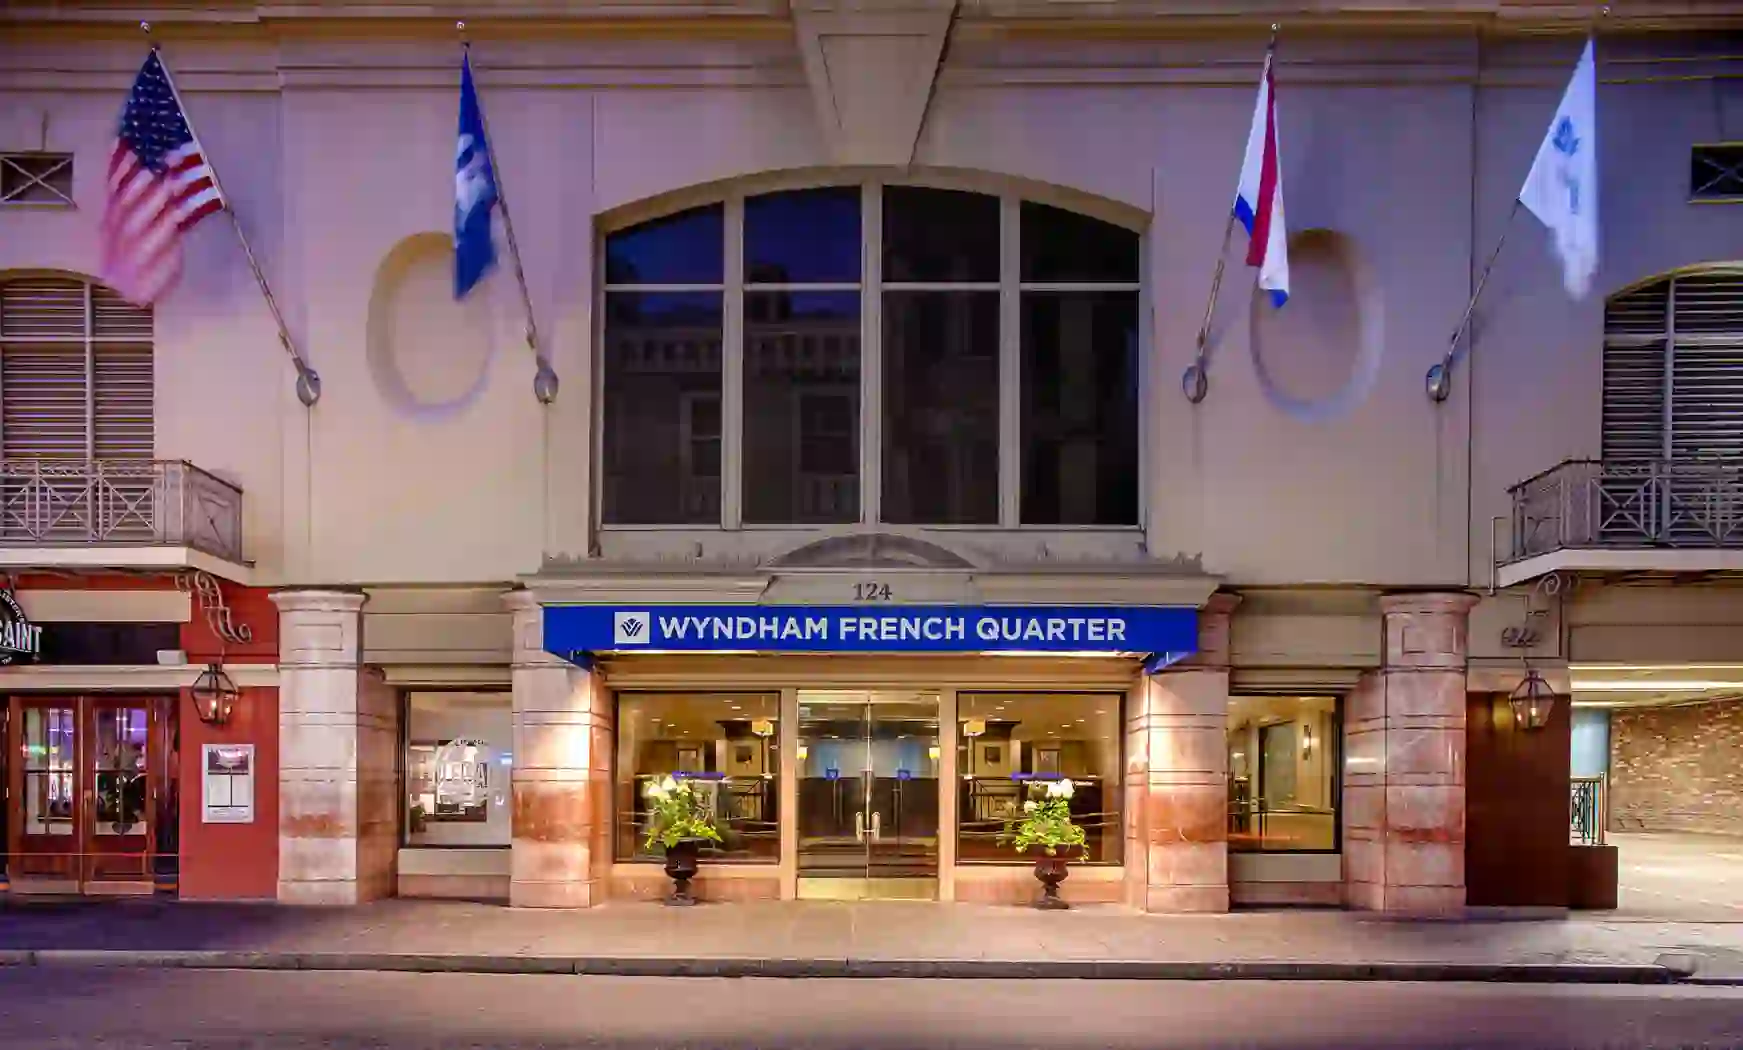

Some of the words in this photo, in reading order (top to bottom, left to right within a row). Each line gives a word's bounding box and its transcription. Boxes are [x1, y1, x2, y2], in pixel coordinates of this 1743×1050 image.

[853, 583, 893, 601] 124
[0, 620, 42, 653] AINT
[659, 616, 828, 640] WYNDHAM
[839, 617, 965, 640] FRENCH
[976, 617, 1126, 641] QUARTER
